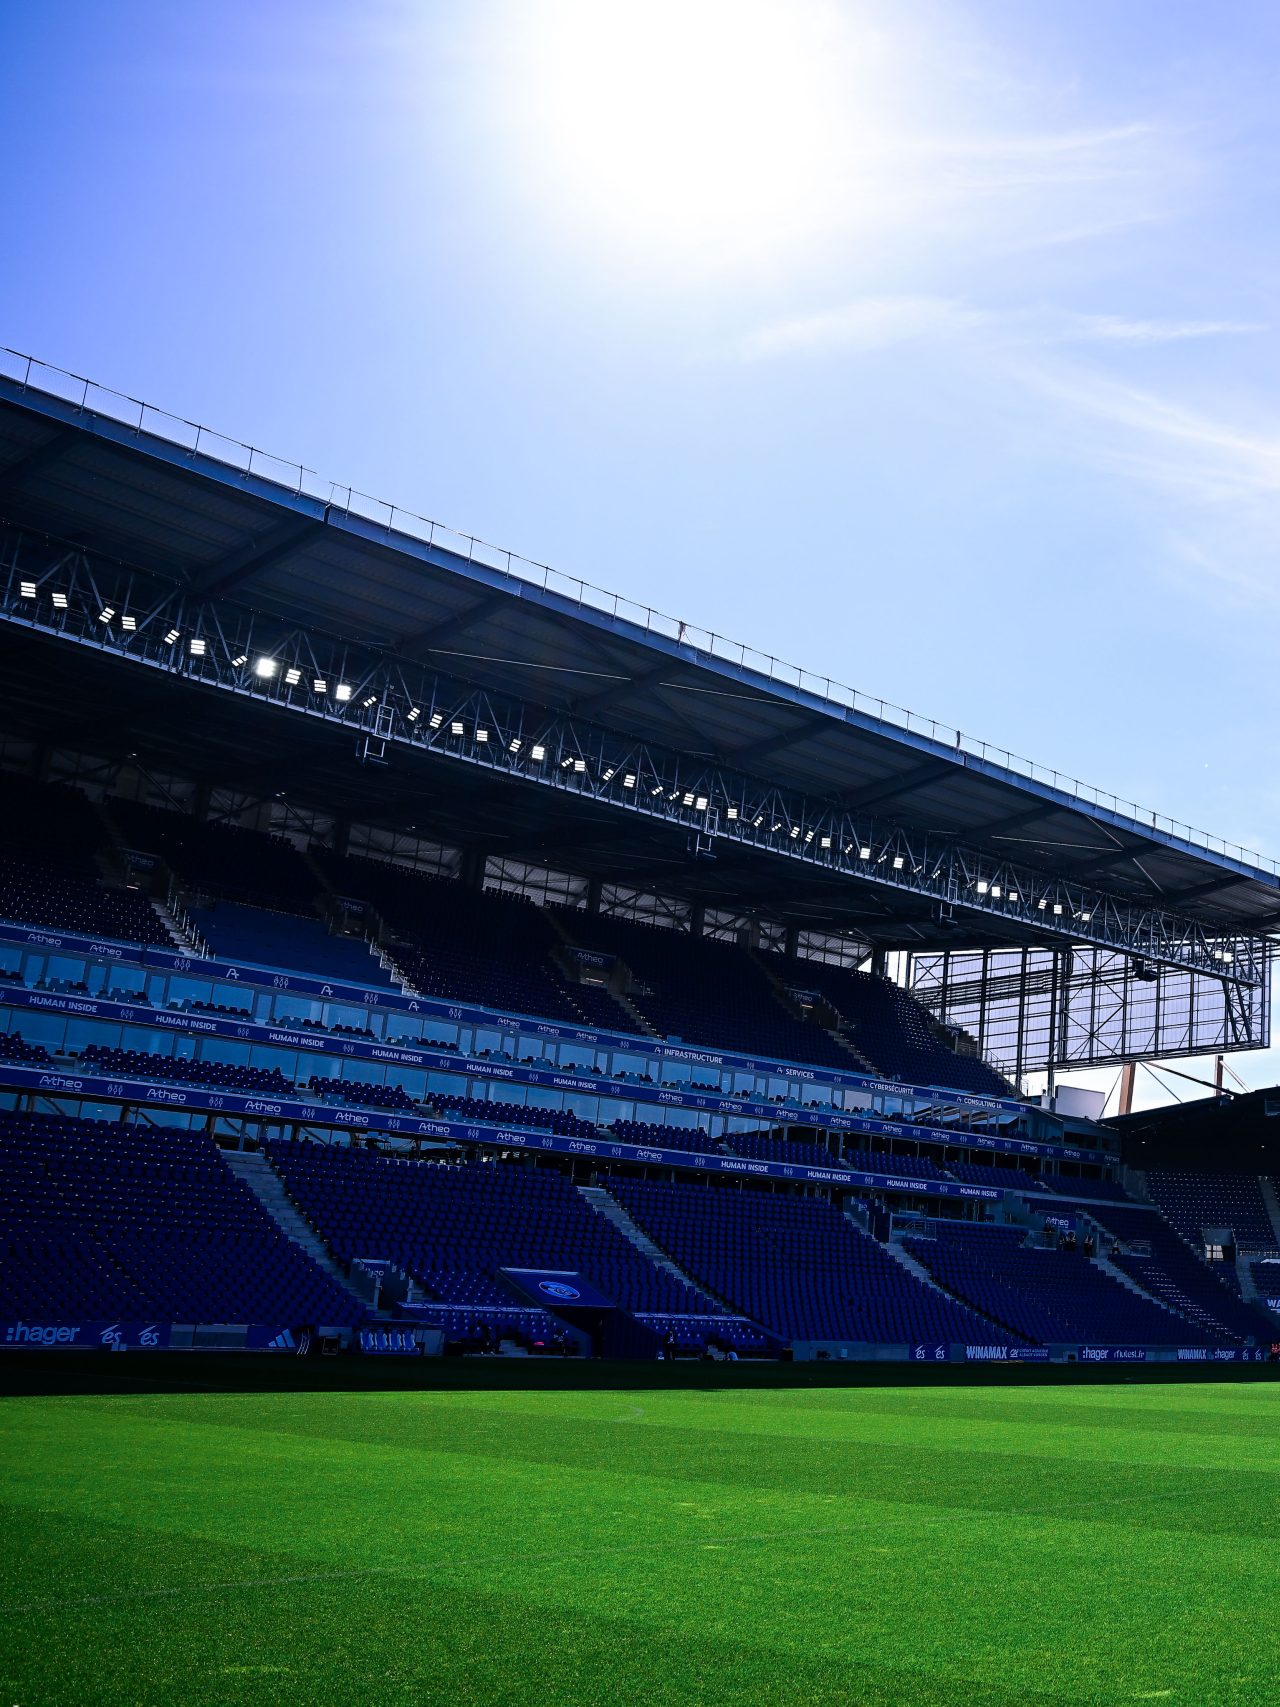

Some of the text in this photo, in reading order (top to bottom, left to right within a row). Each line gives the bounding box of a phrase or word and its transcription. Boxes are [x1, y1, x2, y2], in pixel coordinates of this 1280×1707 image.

[27, 933, 62, 946] Atheo
[89, 944, 122, 957] Atheo
[577, 952, 604, 963] Atheo
[29, 995, 98, 1013] HUMAN INSIDE
[155, 1015, 217, 1031] HUMAN INSIDE
[497, 1017, 521, 1028] Atheo
[537, 1025, 560, 1035] Atheo
[269, 1032, 325, 1048] HUMAN INSIDE
[576, 1031, 598, 1041] Atheo
[371, 1049, 423, 1063] HUMAN INSIDE
[664, 1048, 723, 1064] INFRASTRUCTURE
[466, 1063, 514, 1077] HUMAN INSIDE
[785, 1068, 815, 1079] SERVICES
[39, 1075, 83, 1089] Atheo
[553, 1077, 597, 1090] HUMAN INSIDE
[869, 1082, 914, 1095] CYBERSÉCURITÉ
[146, 1088, 187, 1101] Atheo
[658, 1092, 683, 1103] Atheo
[245, 1100, 282, 1113] Atheo
[718, 1101, 743, 1111] Atheo
[964, 1097, 996, 1108] CONSULTING
[335, 1111, 369, 1124] Atheo
[775, 1109, 799, 1119] Atheo
[830, 1117, 850, 1126] Atheo
[418, 1122, 450, 1133] Atheo
[496, 1132, 526, 1142] Atheo
[569, 1141, 597, 1151] Atheo
[636, 1149, 663, 1159] Atheo
[720, 1160, 769, 1173] HUMAN INSIDE
[807, 1170, 852, 1182] HUMAN INSIDE
[886, 1179, 928, 1190] HUMAN INSIDE
[959, 1187, 998, 1198] HUMAN INSIDE
[1045, 1216, 1070, 1226] Atheo
[966, 1345, 1008, 1359] WINAMAX
[1177, 1349, 1207, 1360] WINAMAX
